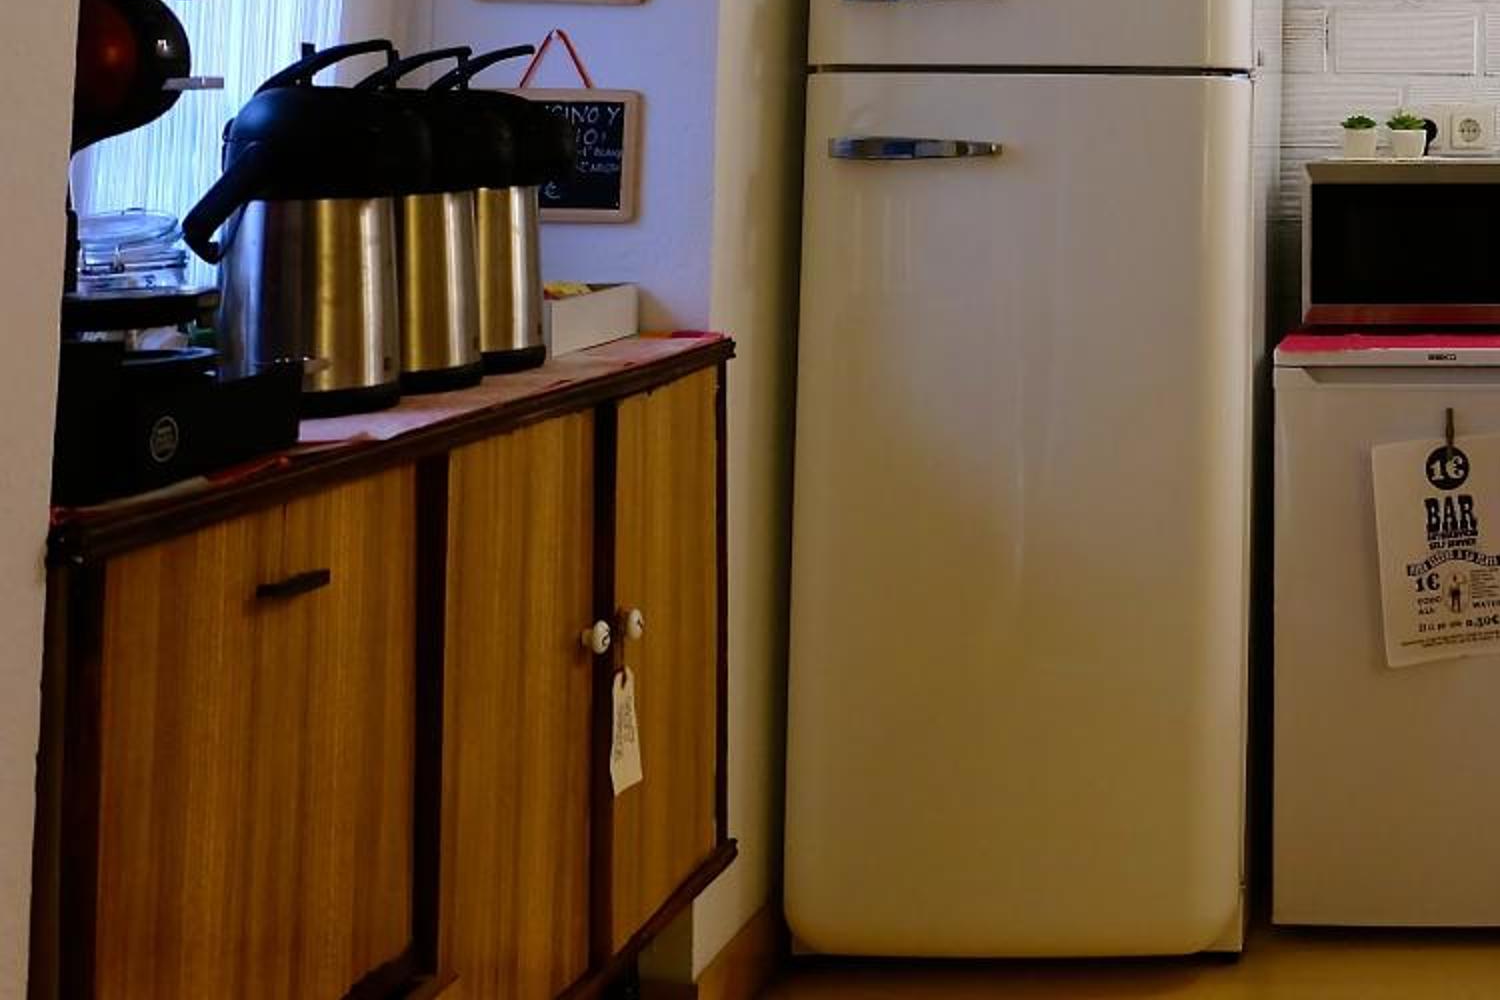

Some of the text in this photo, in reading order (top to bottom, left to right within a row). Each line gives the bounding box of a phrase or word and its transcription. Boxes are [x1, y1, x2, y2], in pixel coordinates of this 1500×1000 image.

[1429, 455, 1466, 481] 1€
[1424, 494, 1478, 533] BAR
[1415, 573, 1440, 592] 1€
